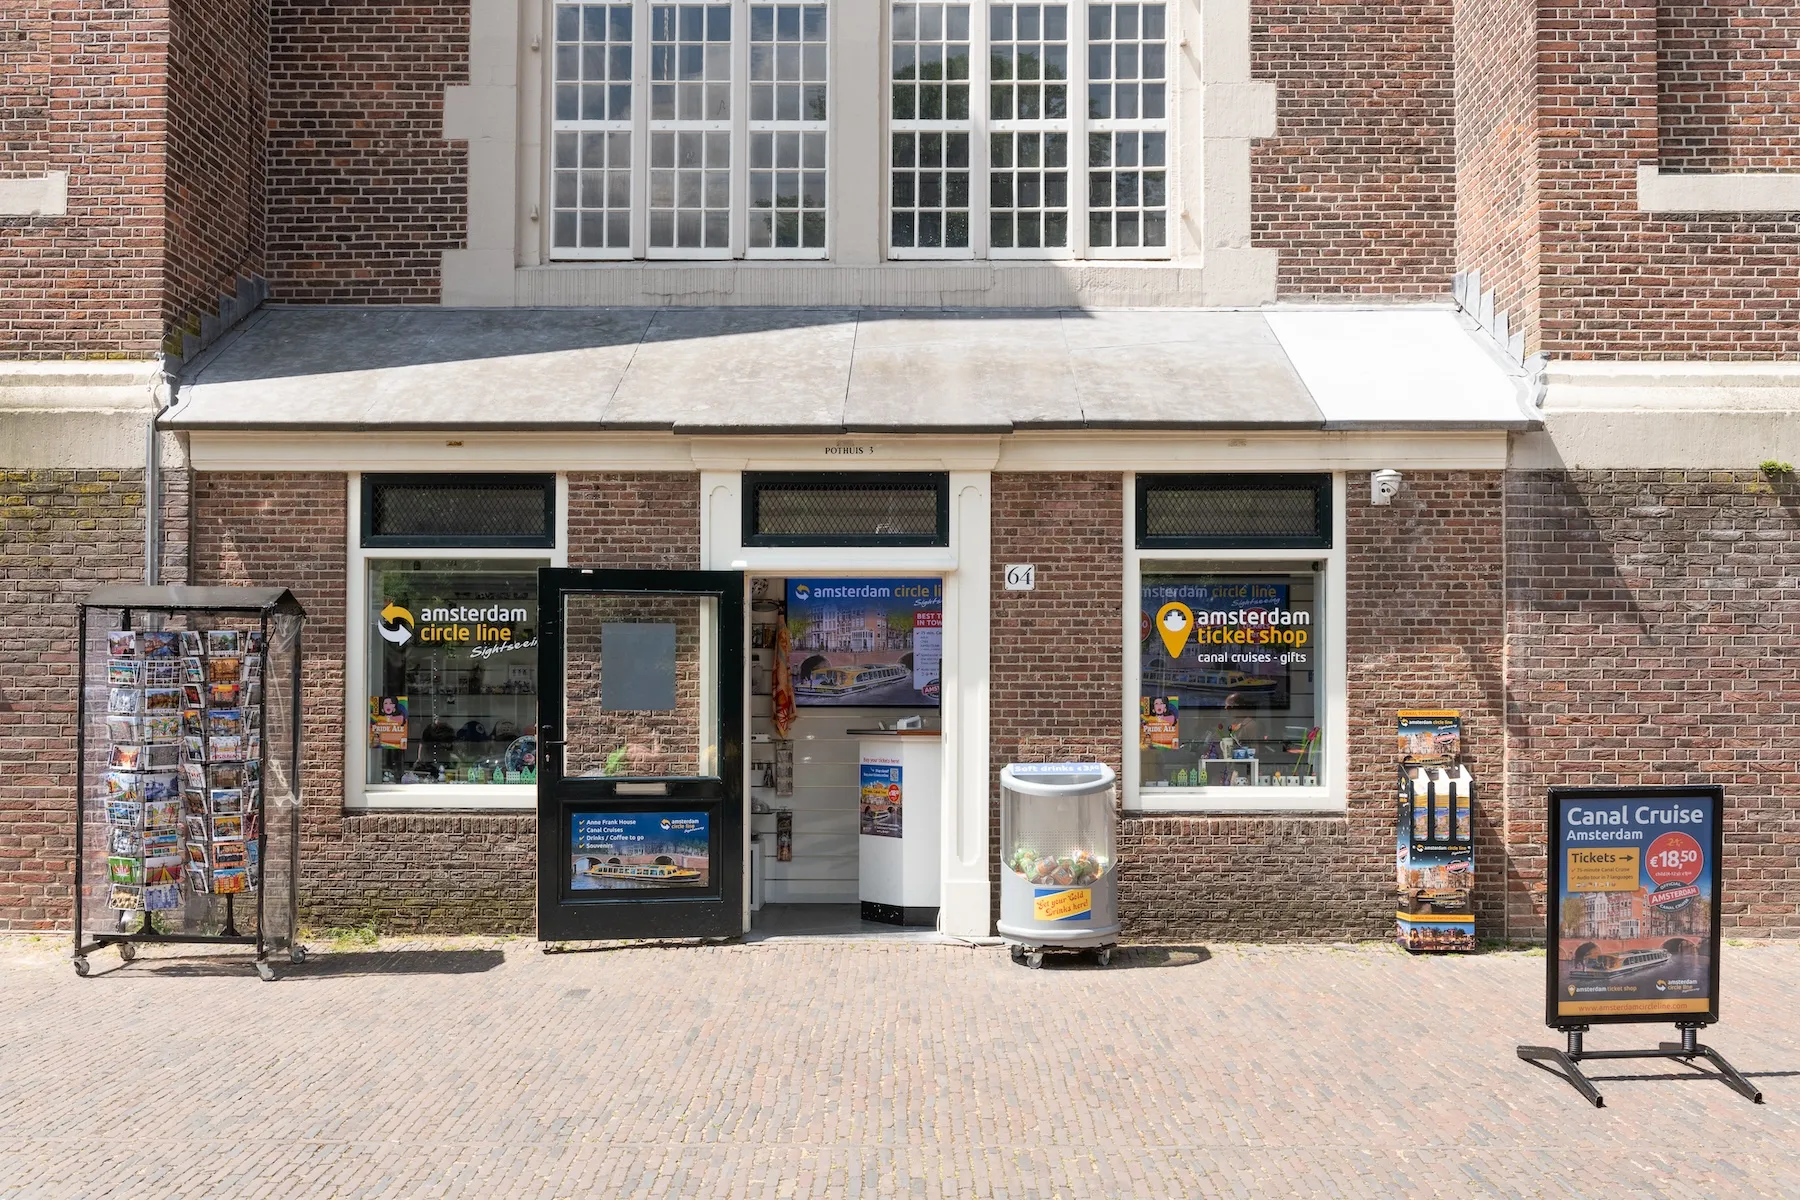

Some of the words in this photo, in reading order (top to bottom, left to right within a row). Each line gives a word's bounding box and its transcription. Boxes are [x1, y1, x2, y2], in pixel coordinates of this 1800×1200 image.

[1008, 566, 1033, 585] 64
[814, 584, 890, 598] amsterdam
[894, 584, 929, 598] circle
[1141, 586, 1208, 598] msterdam
[1212, 585, 1248, 598] circle
[1252, 585, 1276, 598] line
[1230, 598, 1281, 608] Sightseeing
[420, 604, 527, 622] amsterdam
[1198, 608, 1310, 626] amsterdam
[420, 624, 470, 641] circle
[476, 624, 512, 641] line
[1198, 626, 1256, 644] ticket
[1258, 626, 1308, 648] shop
[1198, 652, 1228, 663] canal
[1231, 652, 1270, 663] cruises
[1280, 652, 1306, 665] gifts
[1568, 805, 1628, 825] Canal
[1635, 804, 1704, 824] Cruise
[1566, 828, 1643, 840] Amsterdam
[1572, 852, 1616, 863] Tickets
[1650, 850, 1697, 869] €18,50
[1037, 900, 1049, 910] Get
[1051, 898, 1067, 908] your
[1652, 888, 1696, 904] AMSTERDAM
[1046, 906, 1071, 916] Drinks
[1073, 899, 1088, 910] here!
[1578, 1002, 1688, 1012] www.amsterdamcircleline.com
